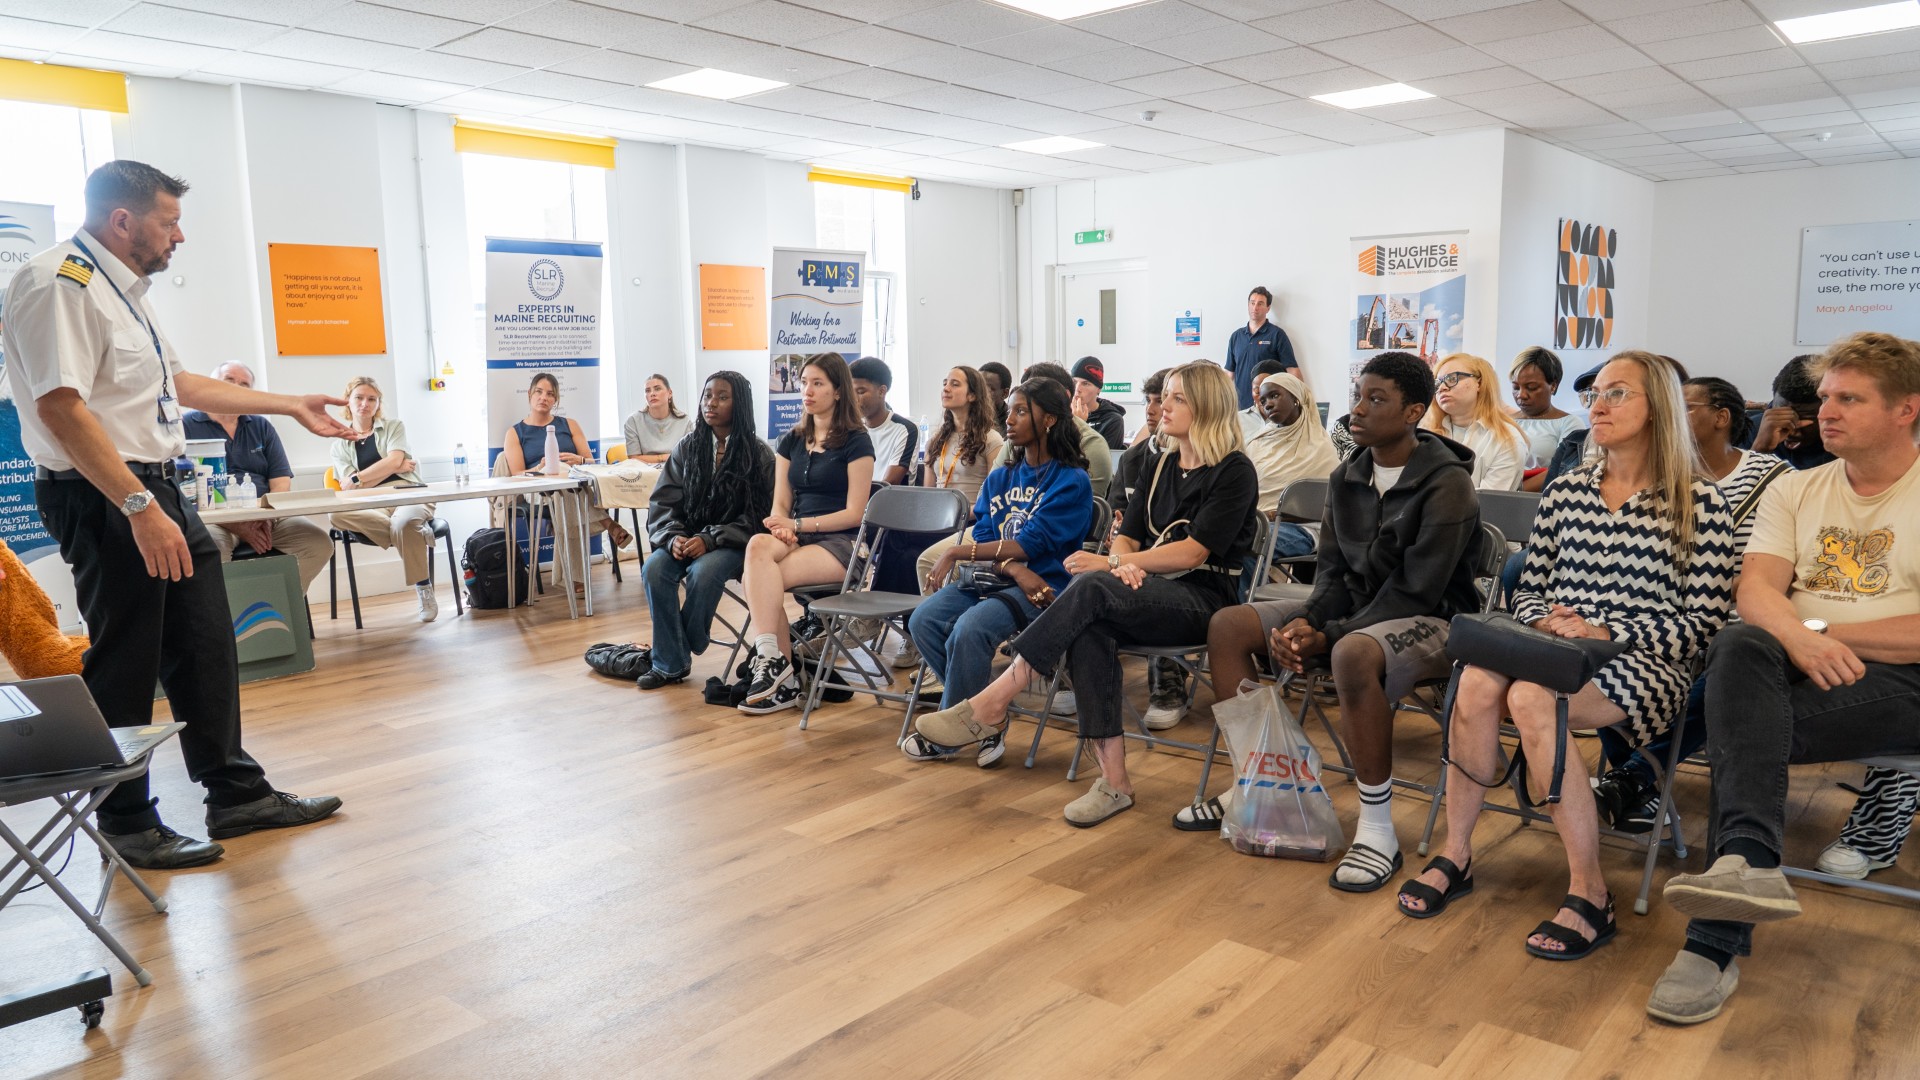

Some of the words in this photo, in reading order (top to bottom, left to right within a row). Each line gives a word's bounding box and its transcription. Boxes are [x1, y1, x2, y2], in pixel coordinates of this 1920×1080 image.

[1388, 244, 1447, 258] HUGHES
[1449, 244, 1459, 255] &
[1851, 251, 1883, 261] can't
[1887, 251, 1910, 259] use
[1388, 256, 1458, 270] SALVIDGE
[534, 268, 557, 280] SLR
[1818, 267, 1880, 278] creativity.
[1884, 266, 1908, 275] The
[285, 283, 309, 291] getting
[1817, 285, 1842, 294] use,
[1846, 283, 1867, 292] the
[1870, 283, 1905, 292] more
[307, 293, 336, 301] enjoying
[518, 304, 562, 314] EXPERTS
[564, 305, 575, 314] IN
[1816, 306, 1846, 314] Maya
[1848, 304, 1893, 314] Angelou
[494, 314, 536, 323] MARINE
[537, 315, 596, 323] RECRUITING
[790, 311, 821, 330] Working
[823, 311, 835, 326] for
[835, 318, 841, 326] a
[777, 329, 817, 346] Restorative
[819, 329, 857, 345] Portsmouth
[0, 525, 17, 533] ORE
